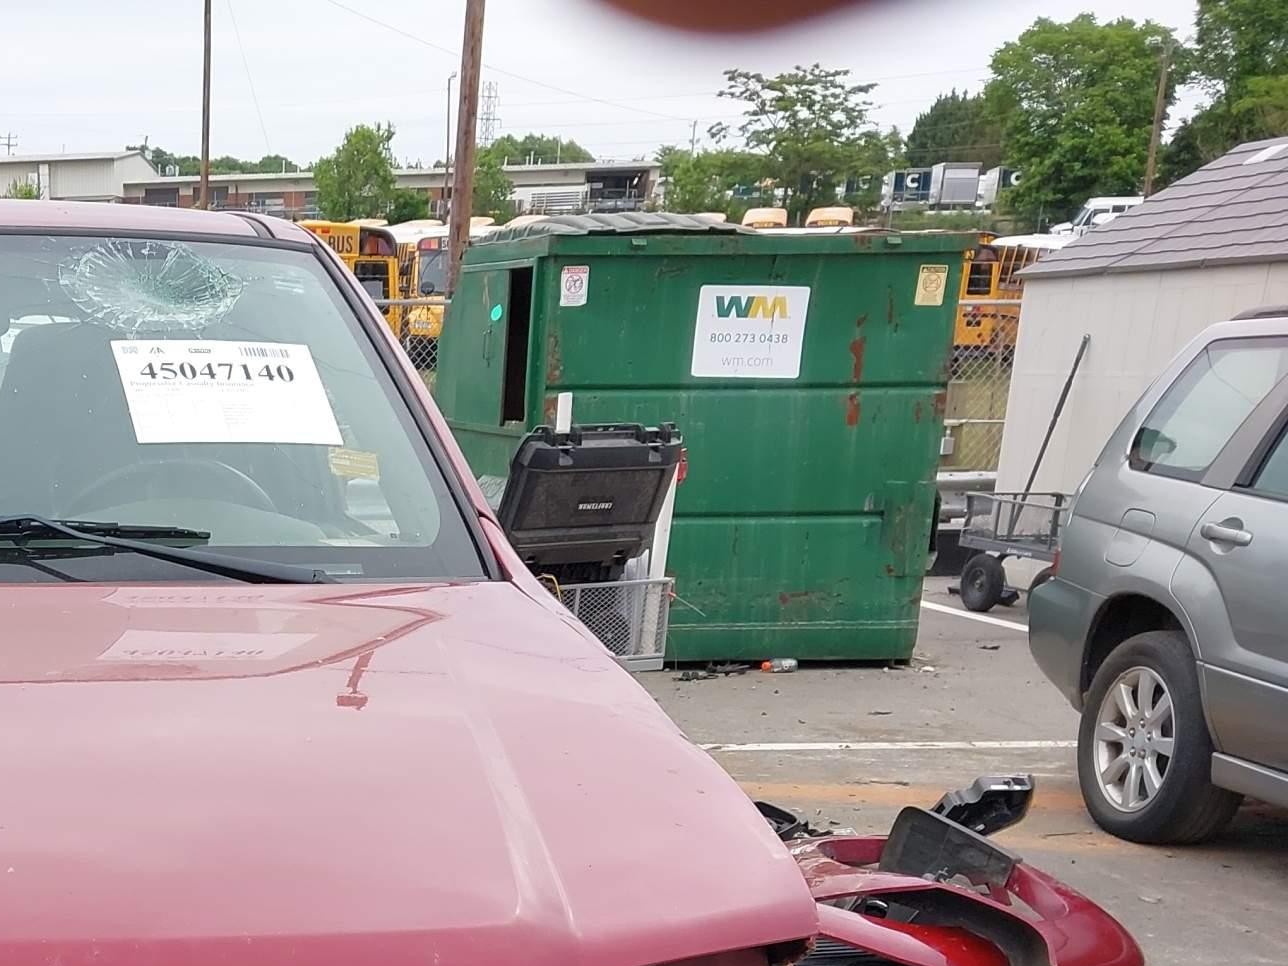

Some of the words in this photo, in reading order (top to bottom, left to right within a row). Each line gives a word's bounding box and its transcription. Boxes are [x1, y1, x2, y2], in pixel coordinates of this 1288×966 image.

[715, 295, 788, 319] WM
[710, 332, 732, 343] 800
[734, 332, 756, 343] 273
[758, 333, 789, 344] 0438
[721, 356, 774, 367] wm.com
[140, 361, 295, 382] 45047140
